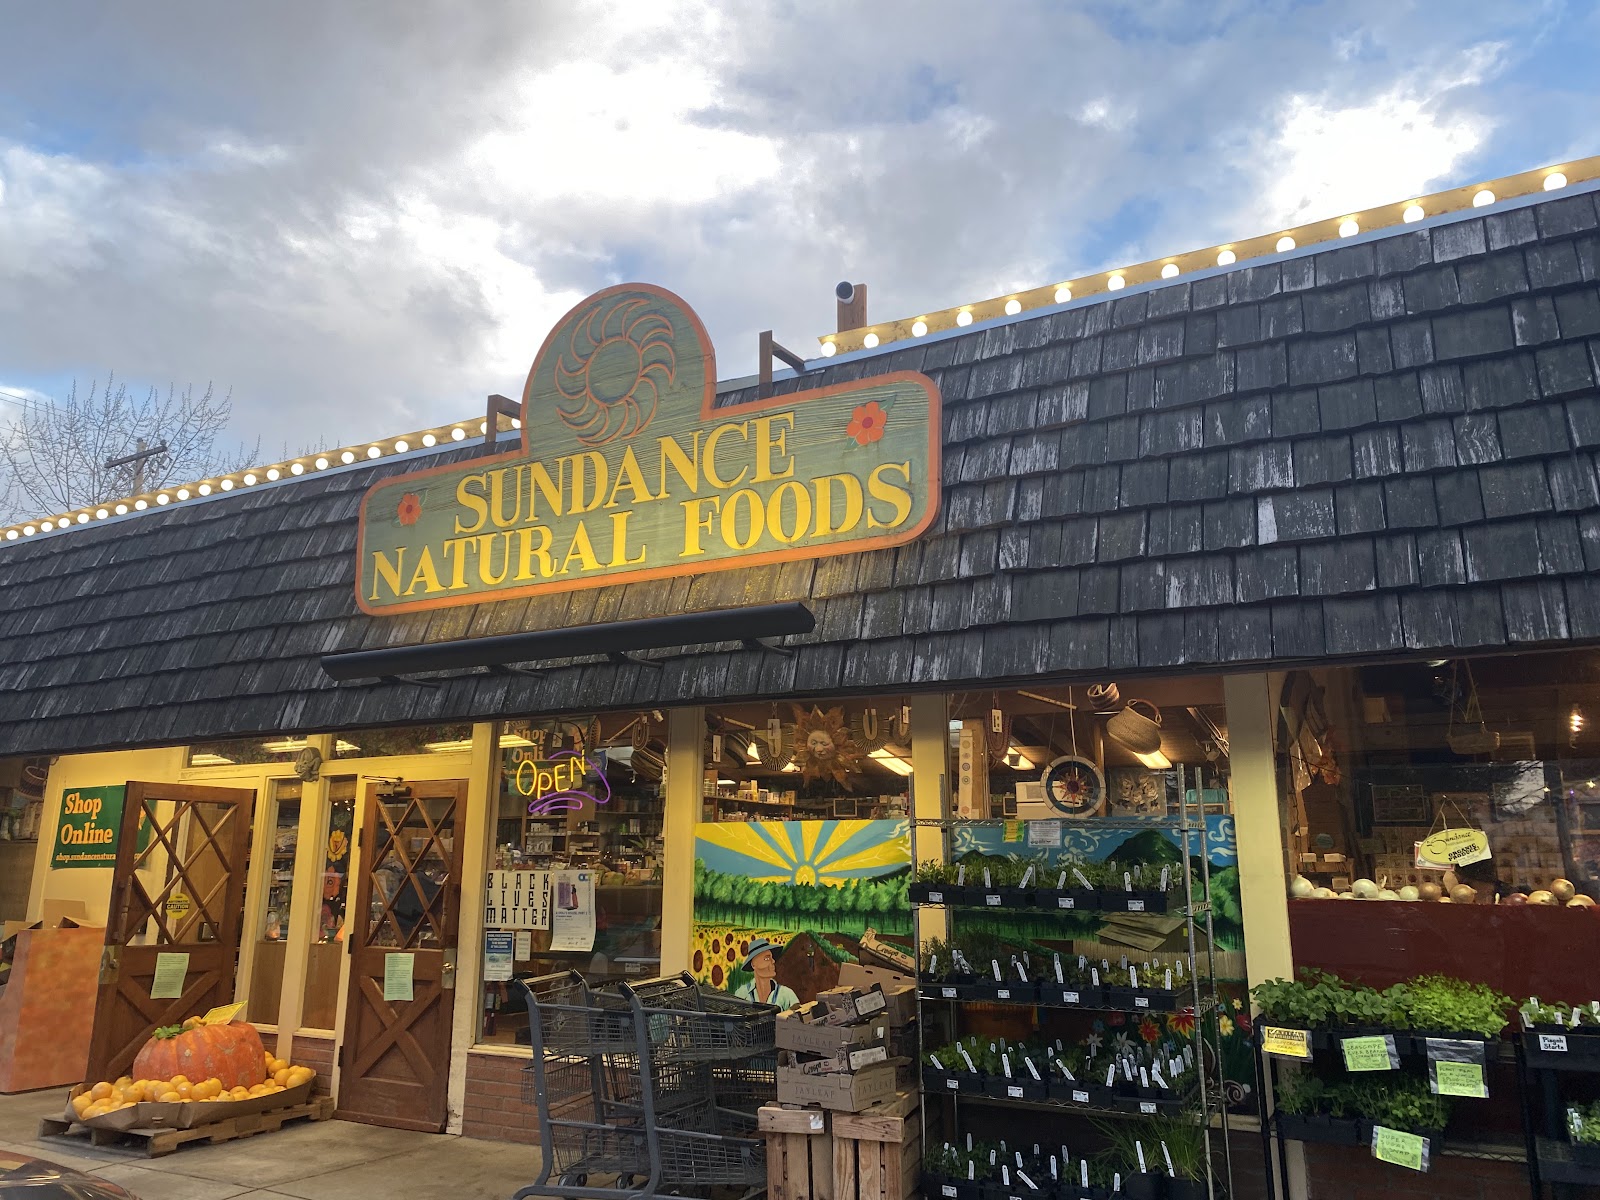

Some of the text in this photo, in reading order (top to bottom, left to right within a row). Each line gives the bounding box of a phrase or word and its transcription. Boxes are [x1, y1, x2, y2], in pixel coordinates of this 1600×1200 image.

[455, 411, 795, 535] SUNDANCE
[370, 461, 912, 600] NATURAL FOODS
[517, 750, 586, 799] OPEN
[65, 792, 102, 819] Shop
[61, 822, 113, 845] Online
[1448, 843, 1477, 857] ORGANIC
[488, 873, 549, 890] BLACK
[487, 890, 548, 907] LIVES
[486, 908, 547, 925] MATTER
[792, 1034, 833, 1047] JAYLEAF
[796, 1086, 834, 1098] JAYLEAF
[858, 1081, 893, 1096] JAYLEAF
